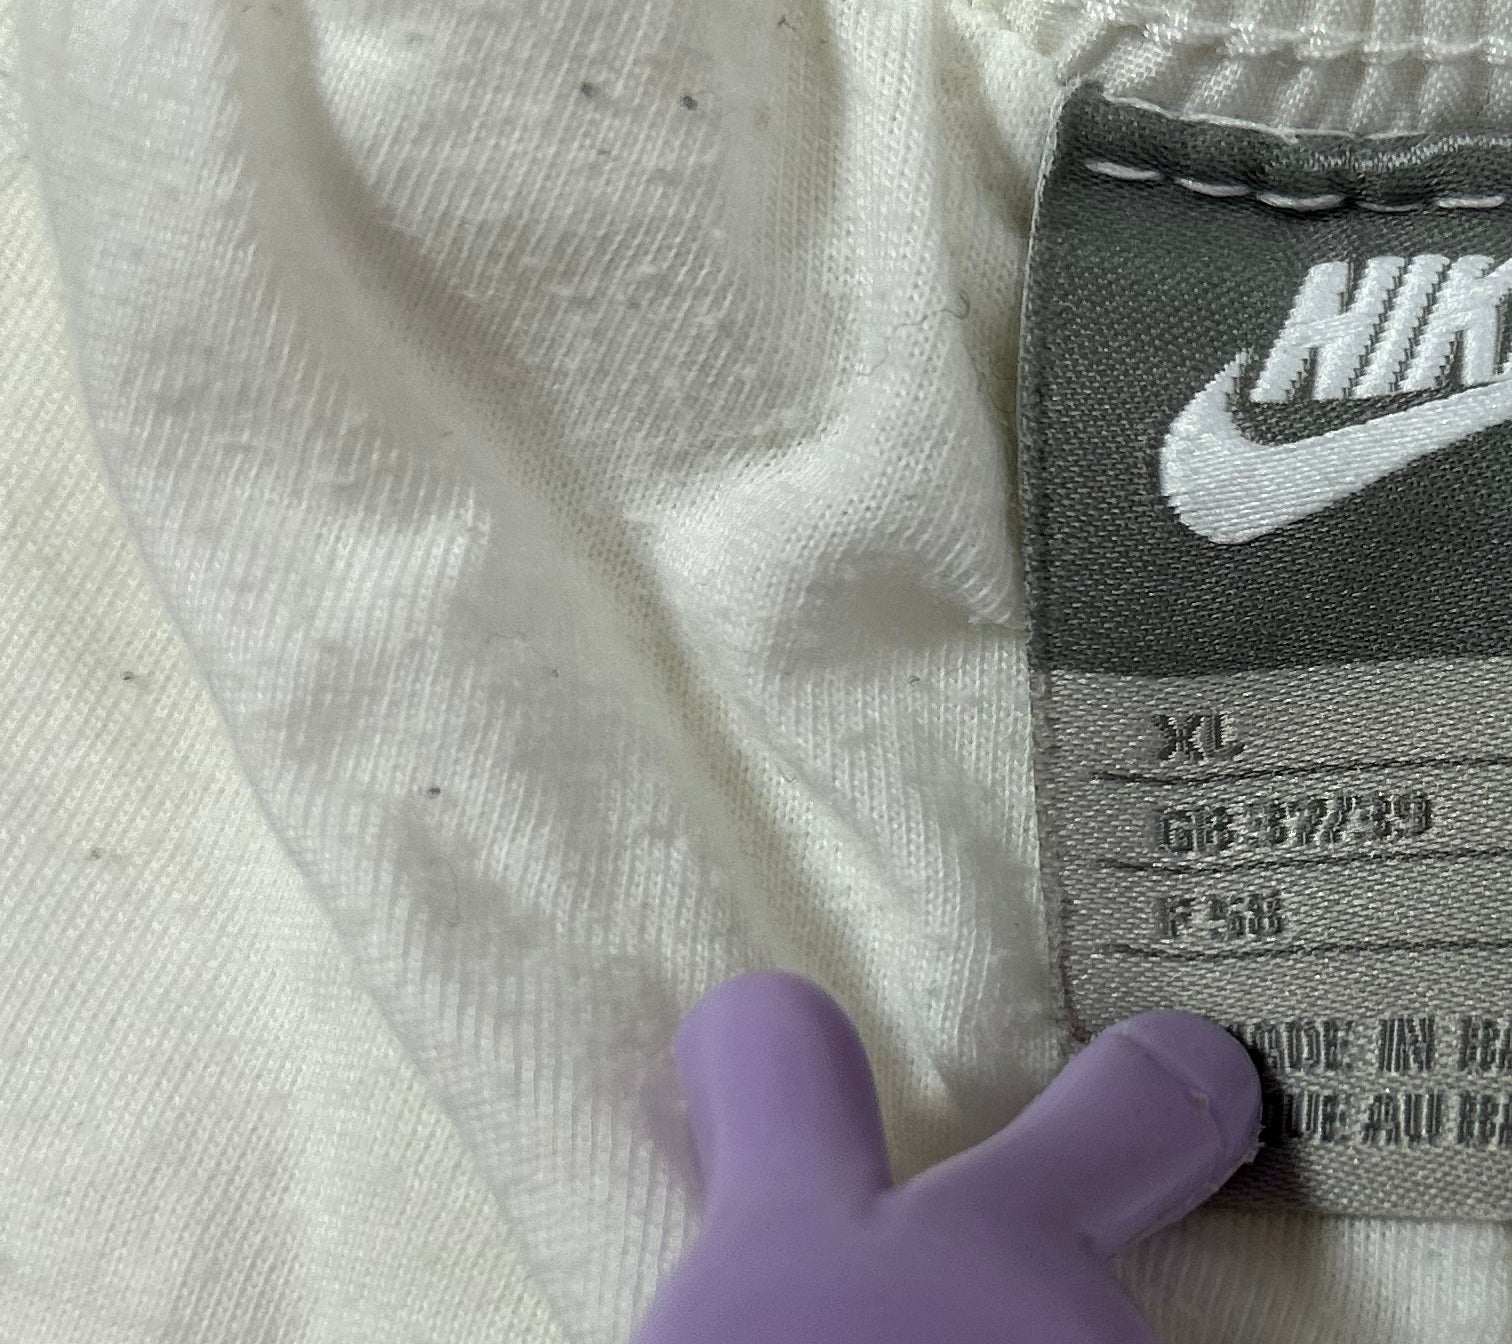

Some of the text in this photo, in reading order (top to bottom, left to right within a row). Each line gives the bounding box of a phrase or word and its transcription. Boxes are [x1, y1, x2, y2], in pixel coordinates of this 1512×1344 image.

[1154, 714, 1246, 760] XL
[1156, 790, 1433, 852] GB 37/39
[1160, 891, 1285, 939] F 58
[1230, 1018, 1352, 1072] ADE
[1378, 1017, 1436, 1072] IN
[1362, 1087, 1444, 1147] AU
